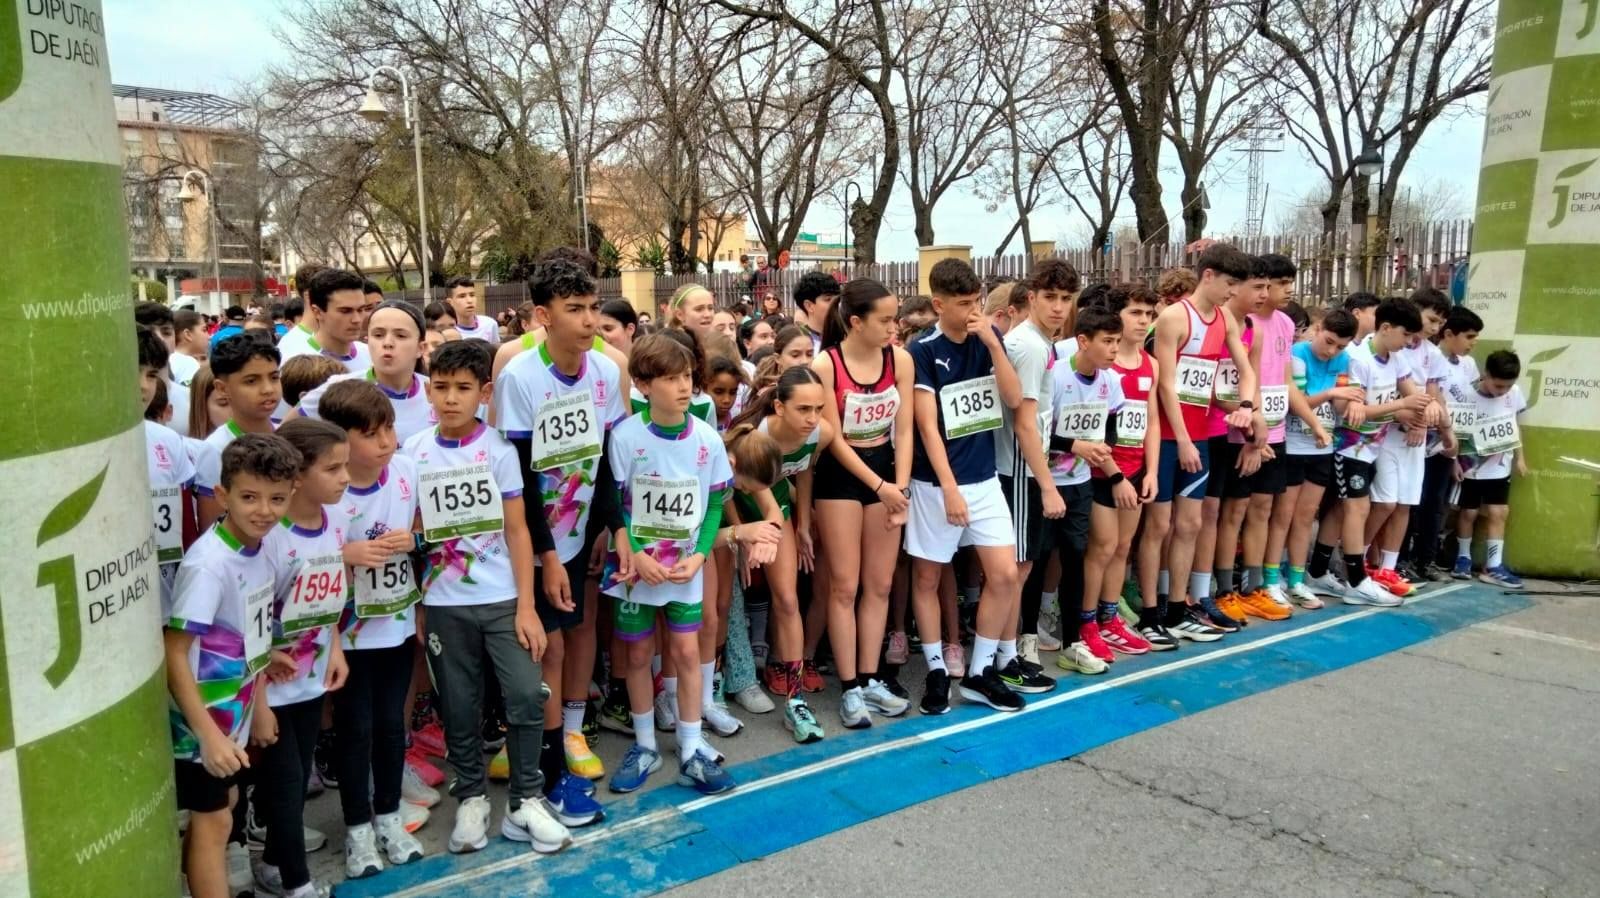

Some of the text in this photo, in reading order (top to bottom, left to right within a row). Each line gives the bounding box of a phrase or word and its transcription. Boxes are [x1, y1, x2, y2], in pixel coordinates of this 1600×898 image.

[30, 29, 100, 68] DE JAÉN
[950, 389, 994, 417] 1385
[1544, 388, 1559, 397] DE
[853, 400, 896, 424] 1392
[1064, 413, 1102, 431] 1366
[1450, 411, 1474, 426] 1436
[538, 409, 589, 444] 1353
[1479, 421, 1514, 441] 1488
[429, 479, 492, 513] 1535
[642, 491, 694, 517] 1442
[292, 569, 342, 604] 1594
[366, 560, 408, 590] 158
[89, 573, 150, 625] DE JAÉN
